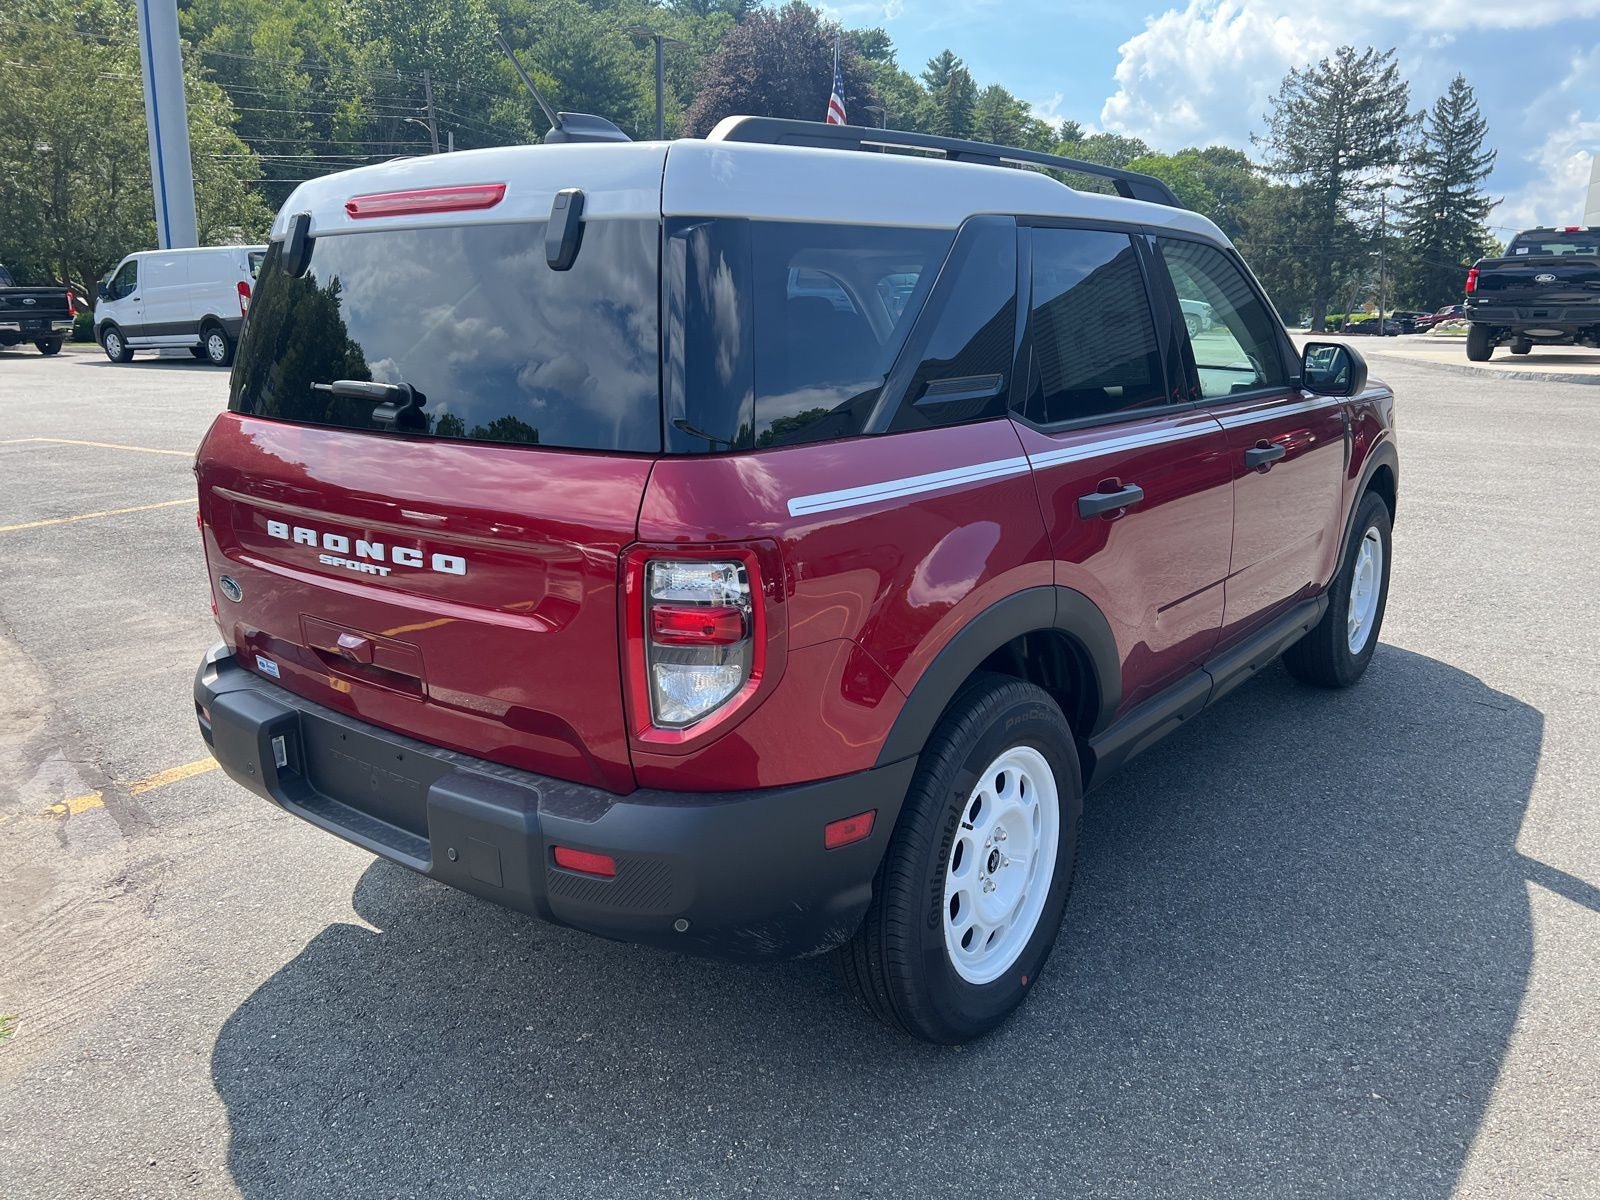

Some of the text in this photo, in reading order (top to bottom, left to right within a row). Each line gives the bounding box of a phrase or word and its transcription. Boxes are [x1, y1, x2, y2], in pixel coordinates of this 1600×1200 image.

[267, 519, 467, 576] BRONCO
[318, 554, 391, 577] SPORT
[926, 804, 960, 931] Continental
